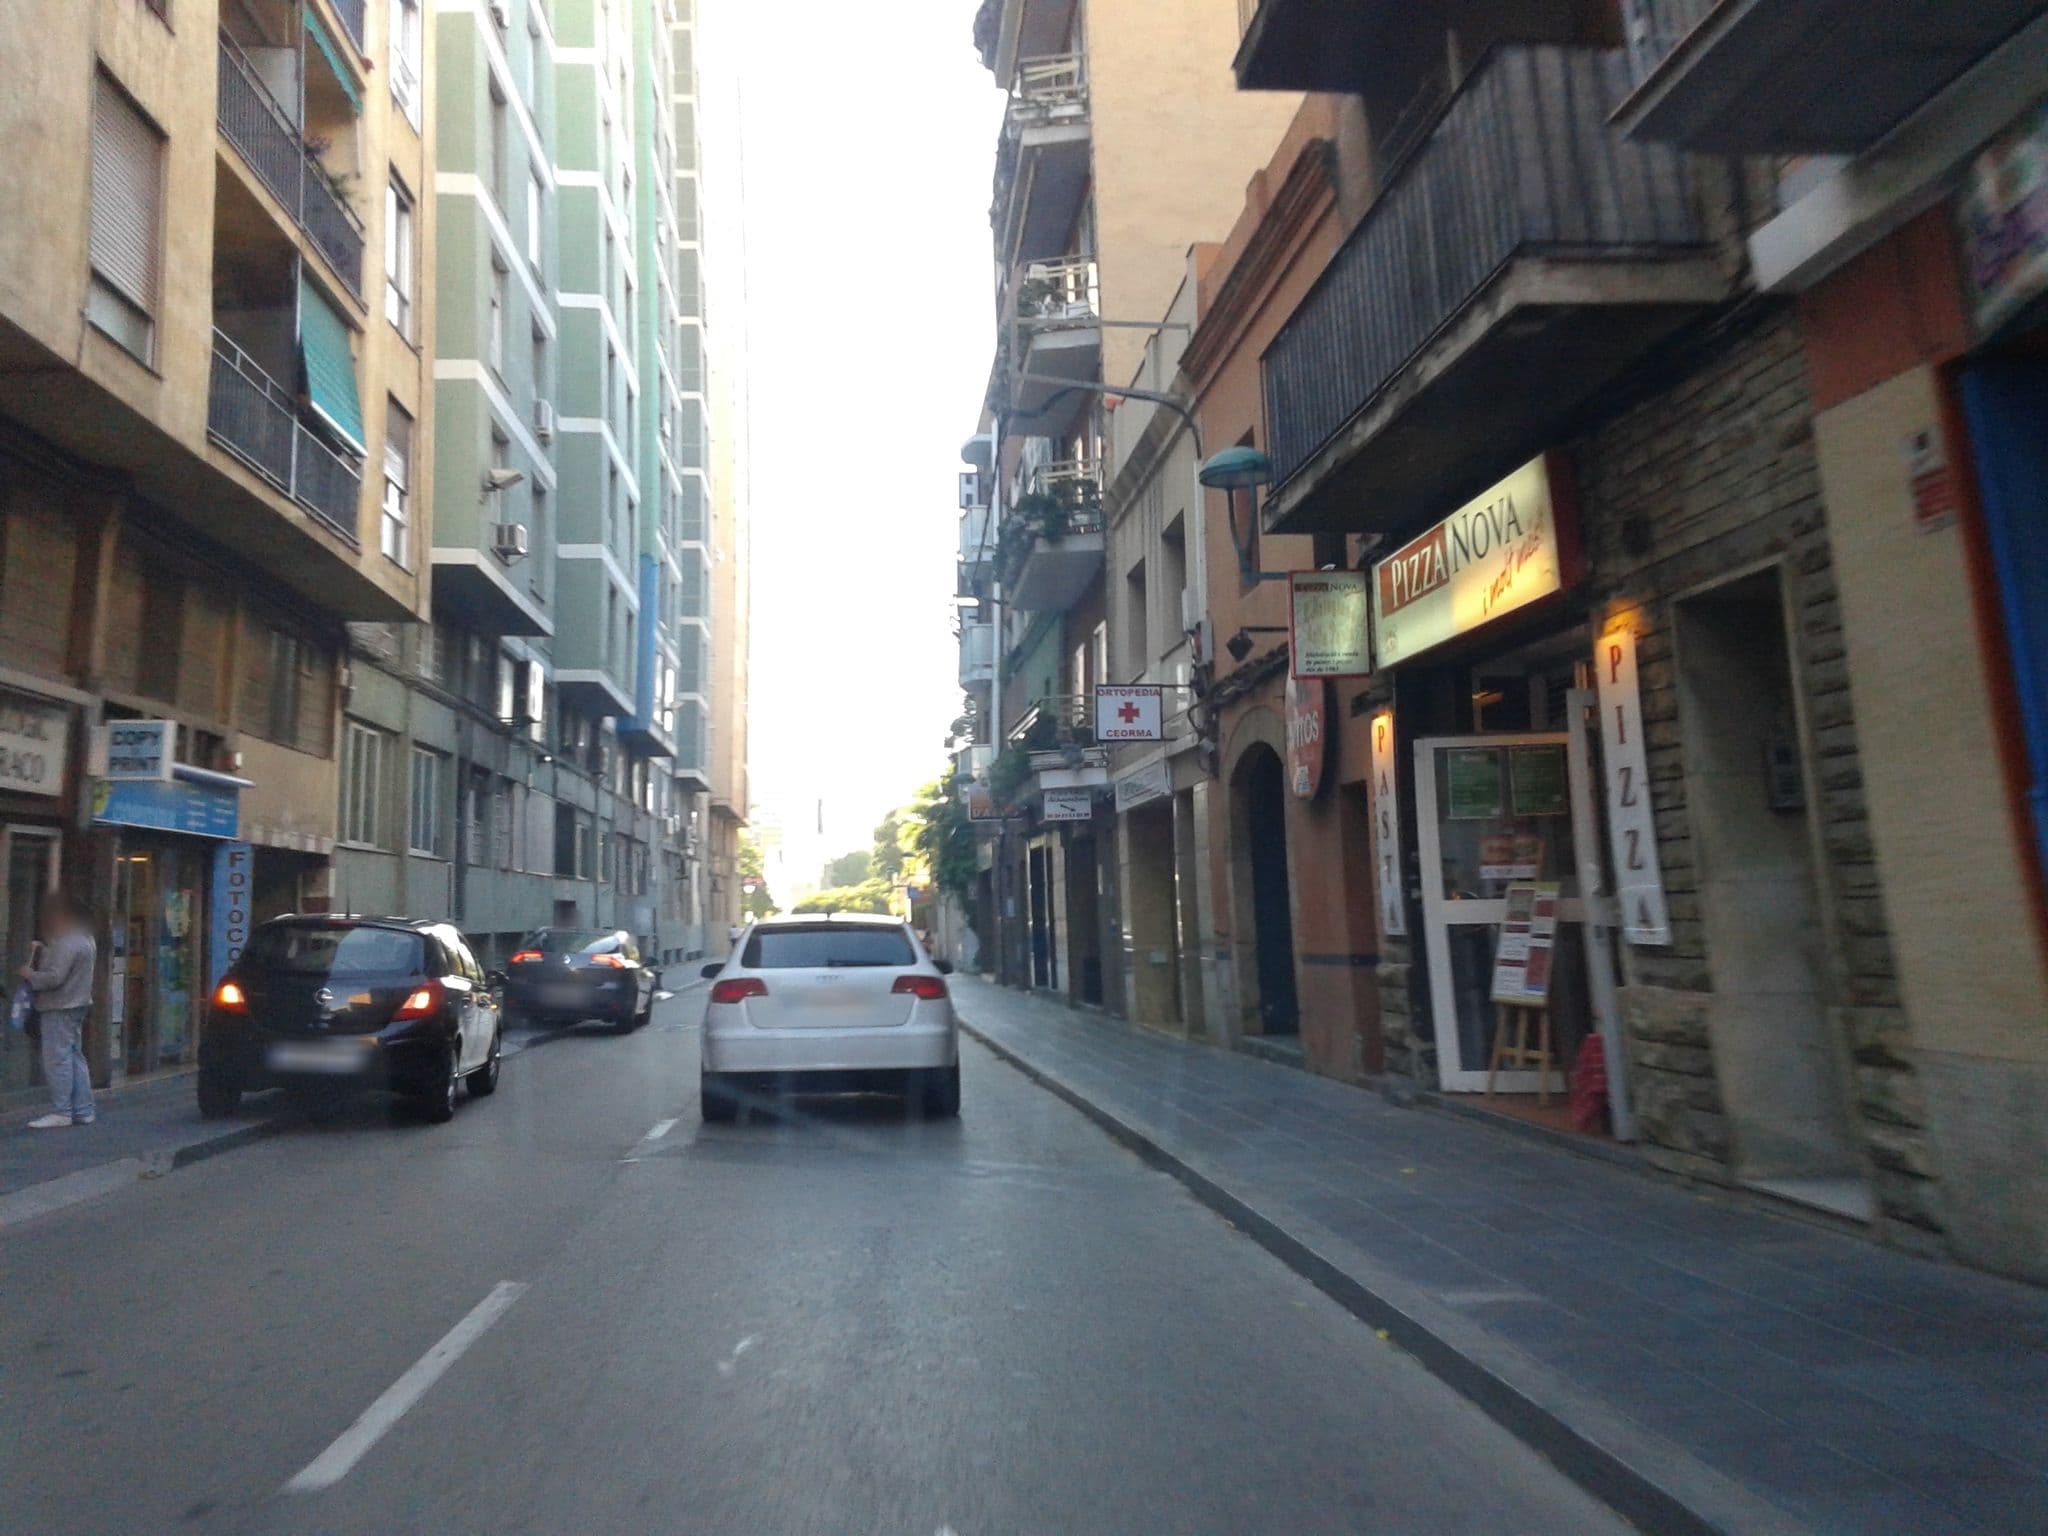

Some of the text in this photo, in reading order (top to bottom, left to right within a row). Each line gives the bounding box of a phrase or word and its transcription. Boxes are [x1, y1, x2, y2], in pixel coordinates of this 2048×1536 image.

[1391, 492, 1523, 609] PIZZA NOVA
[1097, 688, 1161, 697] ORTOPEDIA
[111, 730, 162, 746] COPY
[1105, 729, 1153, 738] CEORMA
[111, 757, 161, 773] PRINT
[1609, 644, 1653, 928] PIZZA
[1376, 724, 1399, 929] PASTA
